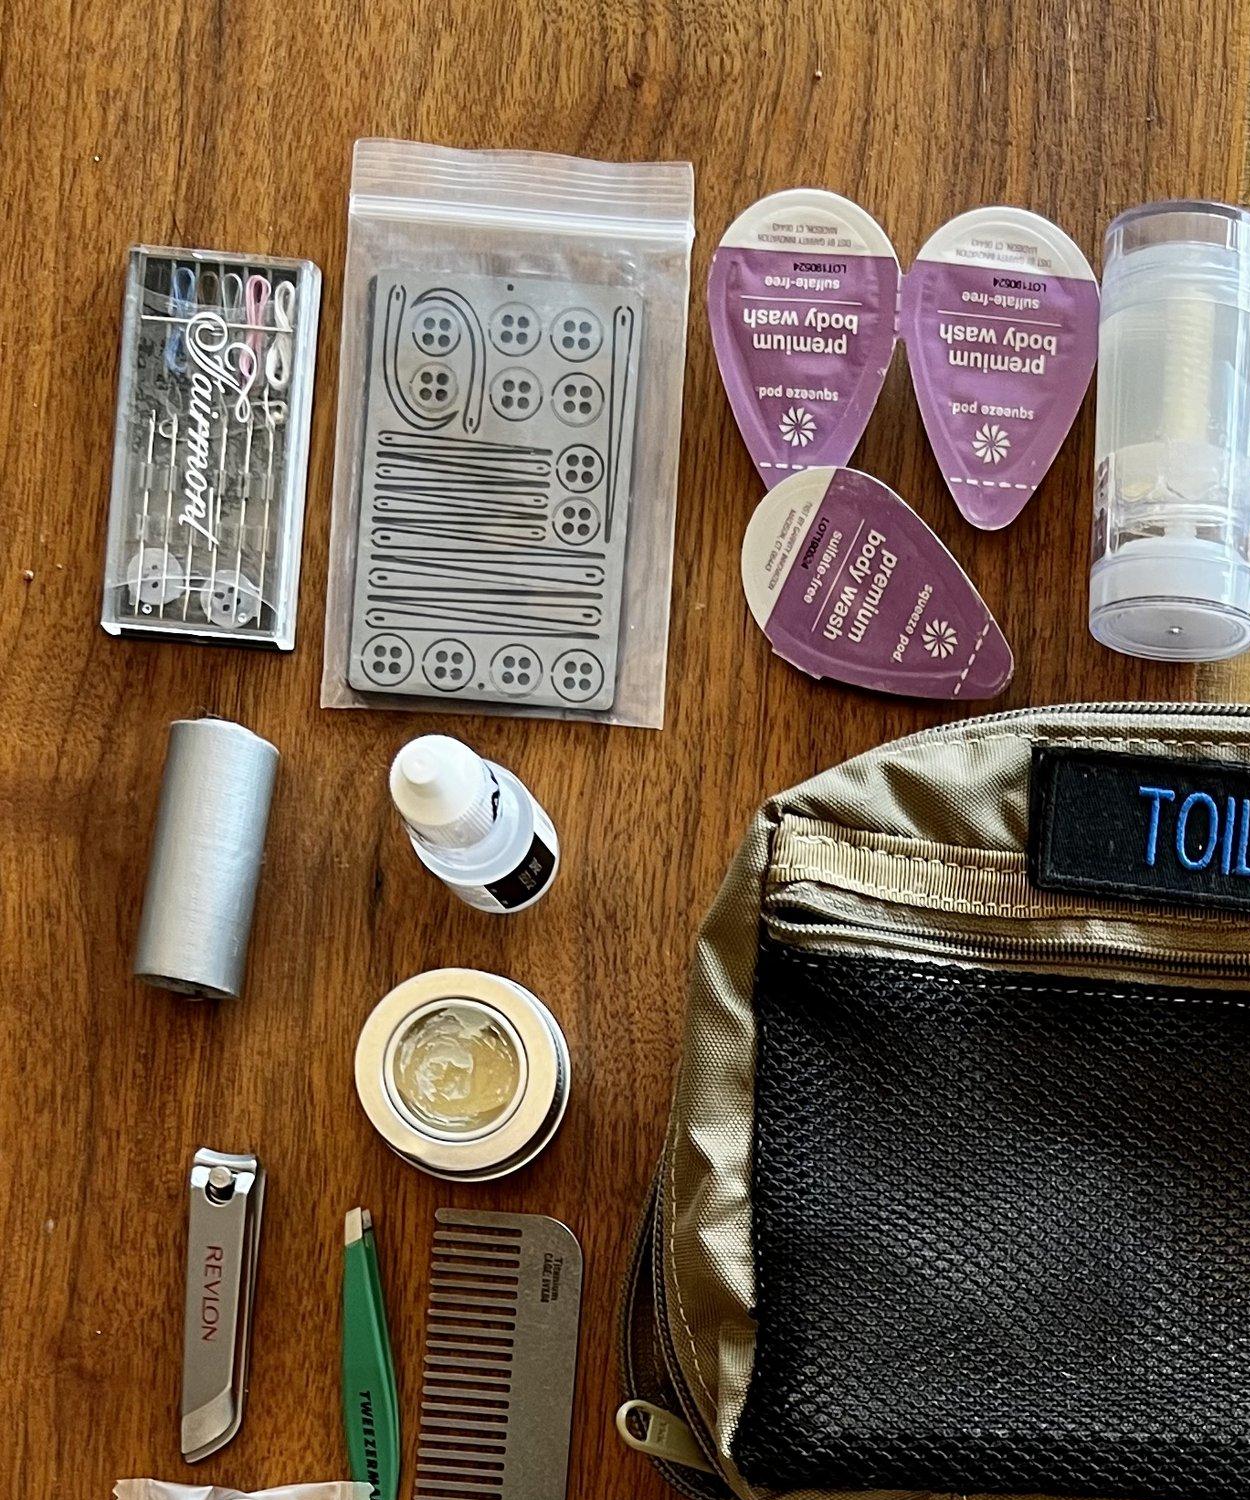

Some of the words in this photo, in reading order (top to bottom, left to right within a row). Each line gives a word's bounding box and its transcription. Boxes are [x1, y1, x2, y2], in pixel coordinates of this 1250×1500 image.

[765, 276, 840, 291] sulfate-free
[743, 307, 799, 326] wash
[804, 310, 859, 334] body
[753, 334, 847, 355] premium
[939, 323, 998, 345] wash
[1002, 327, 1058, 354] body
[948, 350, 1046, 375] premium
[787, 386, 839, 402] squeeze
[178, 311, 260, 551] Fairmont
[849, 529, 887, 584] body
[847, 549, 899, 643] premium
[822, 585, 858, 641] wash
[201, 1244, 224, 1342] REVLON
